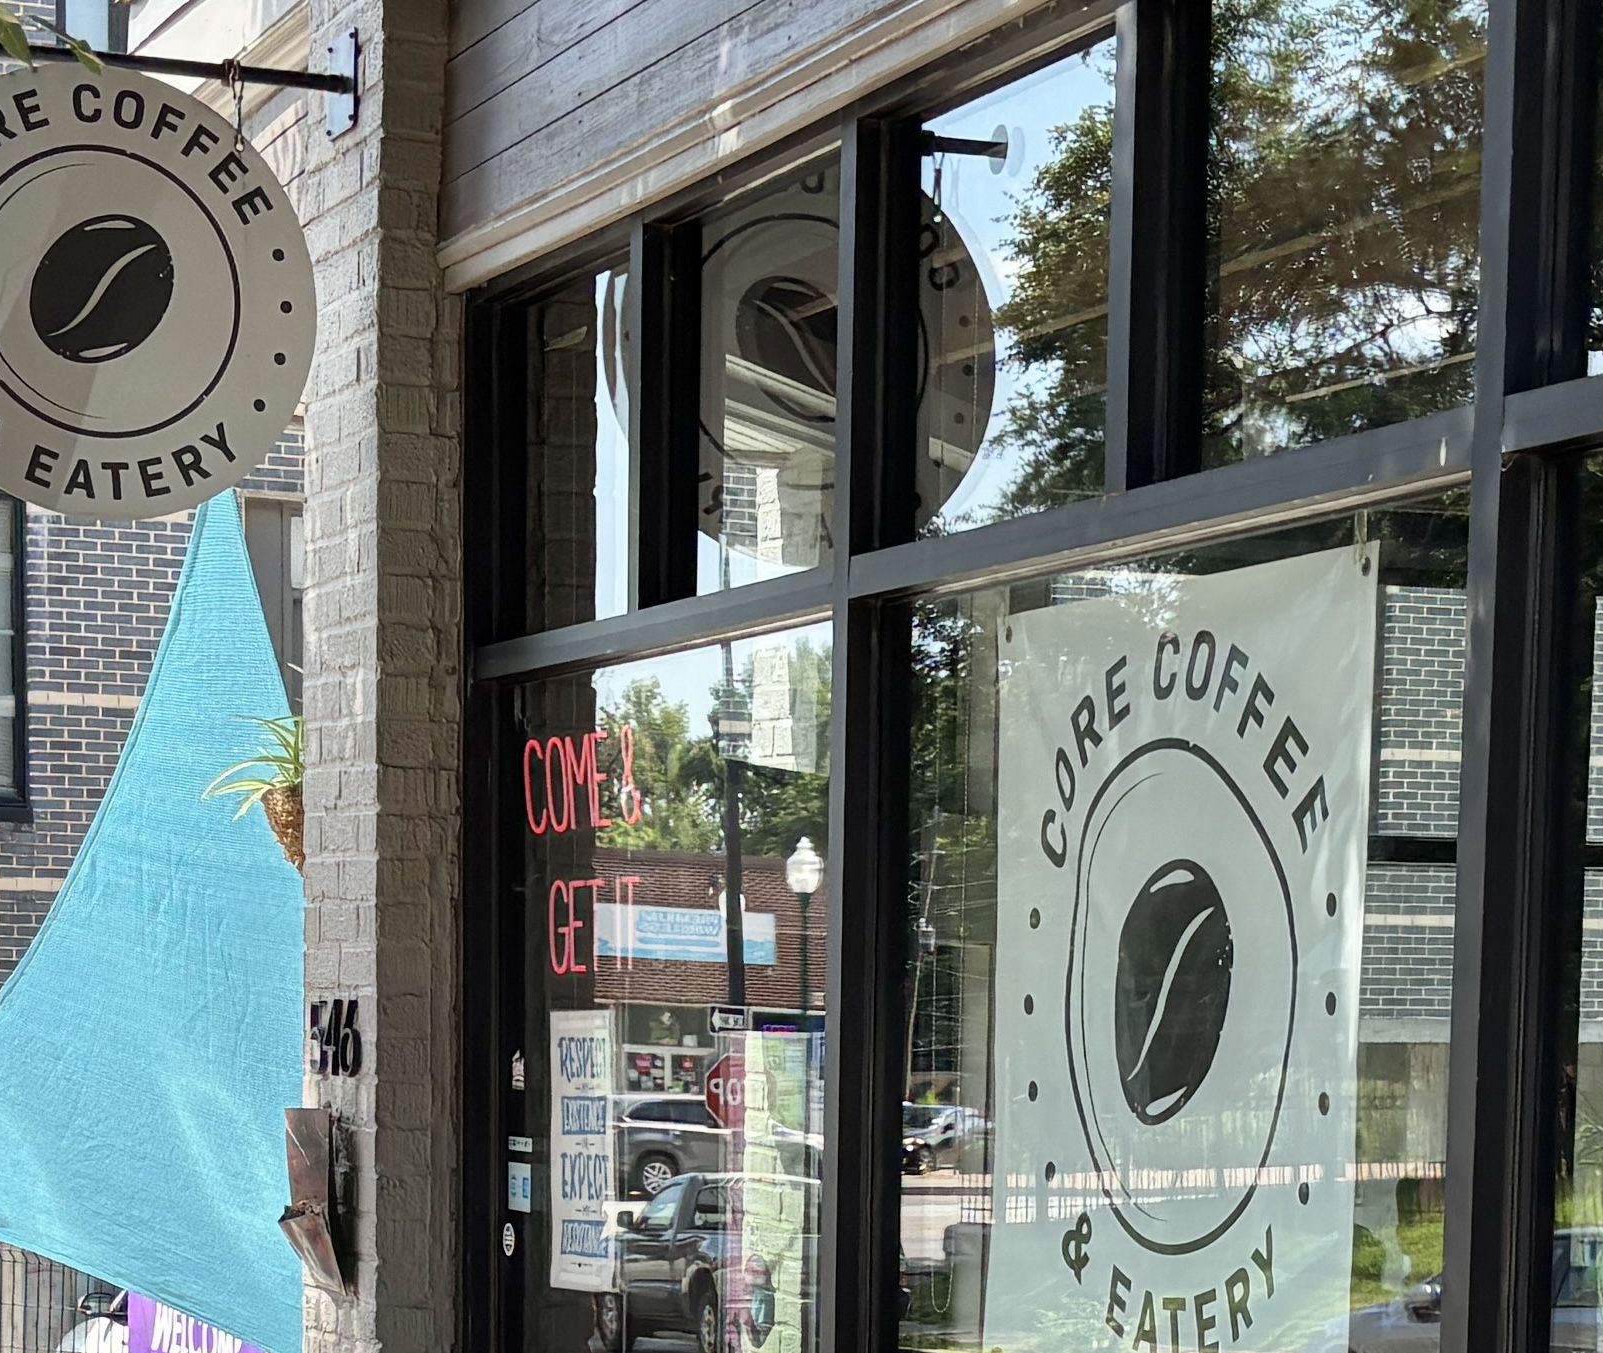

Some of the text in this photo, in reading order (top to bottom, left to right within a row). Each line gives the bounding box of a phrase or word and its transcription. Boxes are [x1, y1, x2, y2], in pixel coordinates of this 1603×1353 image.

[72, 83, 274, 227] COFFEE
[24, 421, 239, 501] EATERY
[523, 723, 643, 836] COME &
[1040, 629, 1330, 869] CORE COFFEE
[548, 876, 640, 975] GET IT
[558, 1036, 606, 1082] RESPECT
[560, 1152, 609, 1201] EXPECT
[1061, 1211, 1093, 1286] &
